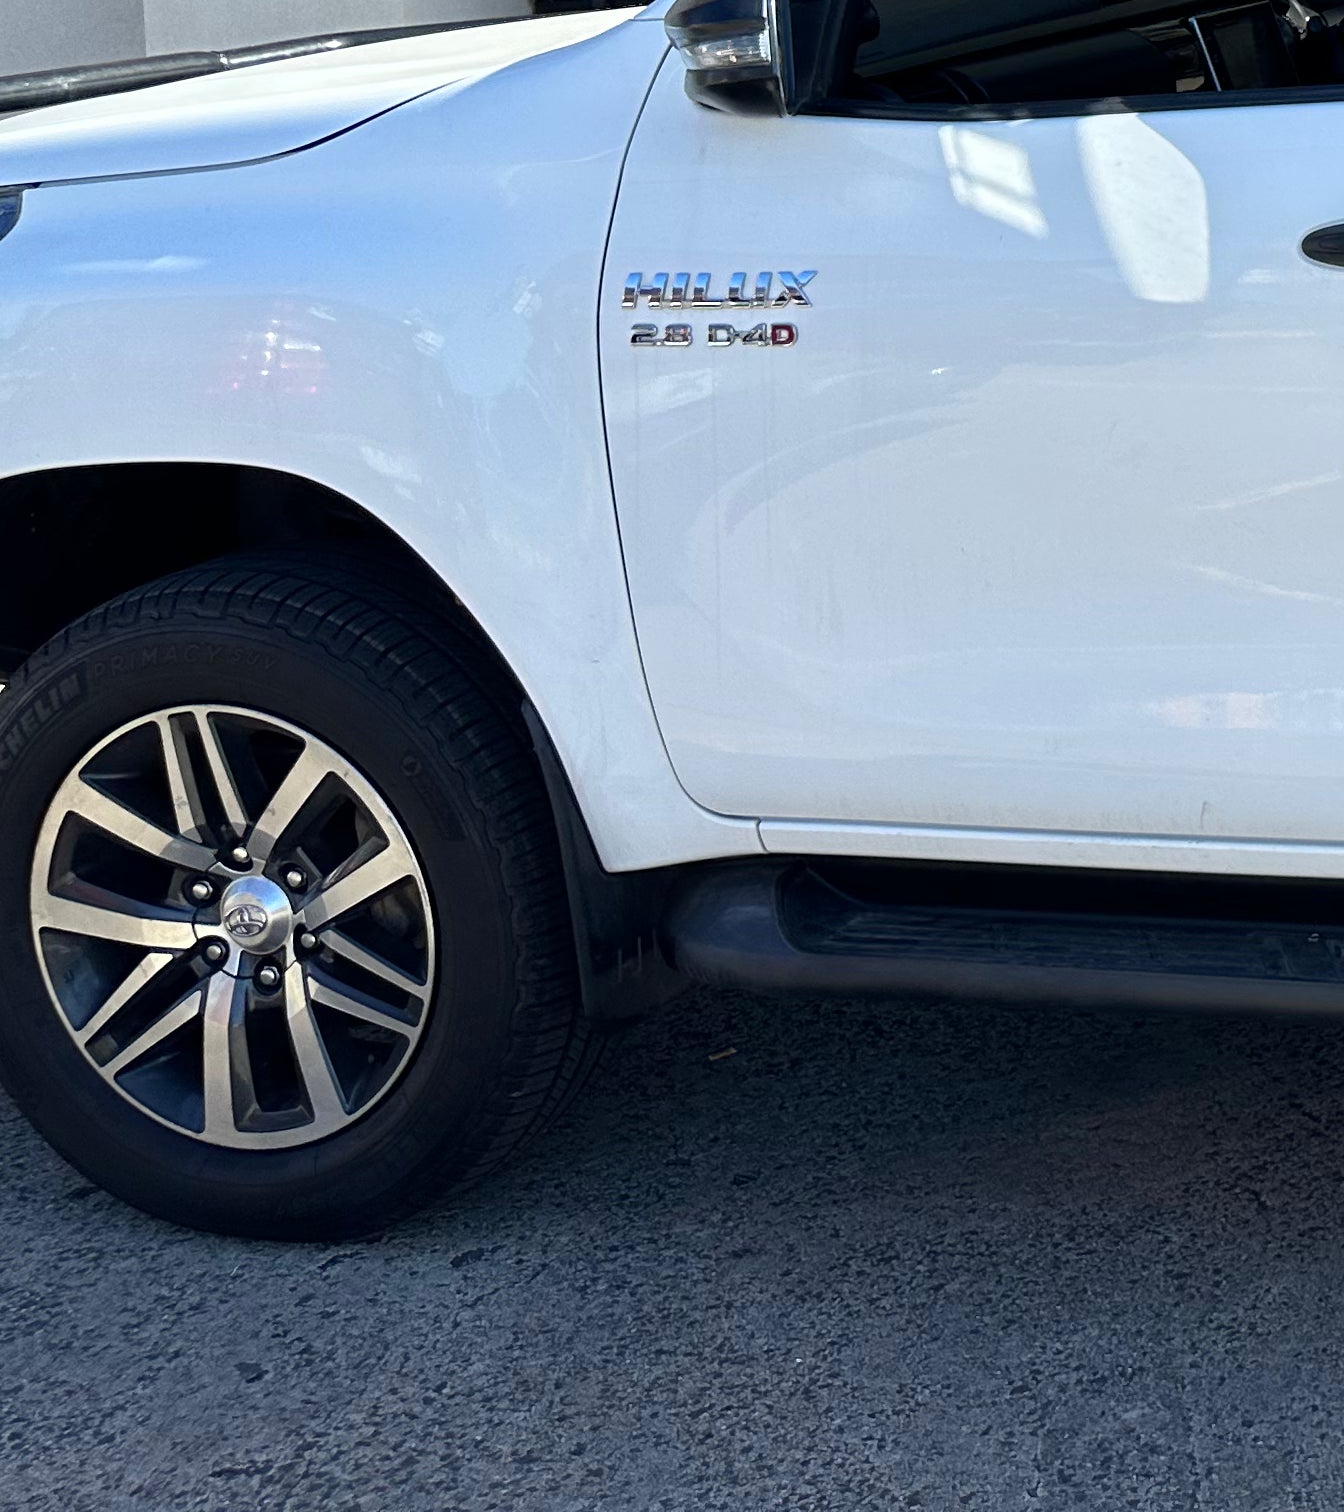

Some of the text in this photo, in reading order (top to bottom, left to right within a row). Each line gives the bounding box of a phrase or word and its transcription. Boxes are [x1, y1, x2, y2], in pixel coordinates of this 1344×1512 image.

[621, 270, 819, 309] HILUX
[630, 322, 799, 347] 2.8 D-4D
[94, 644, 222, 677] PRIMACY
[231, 648, 280, 671] SUV
